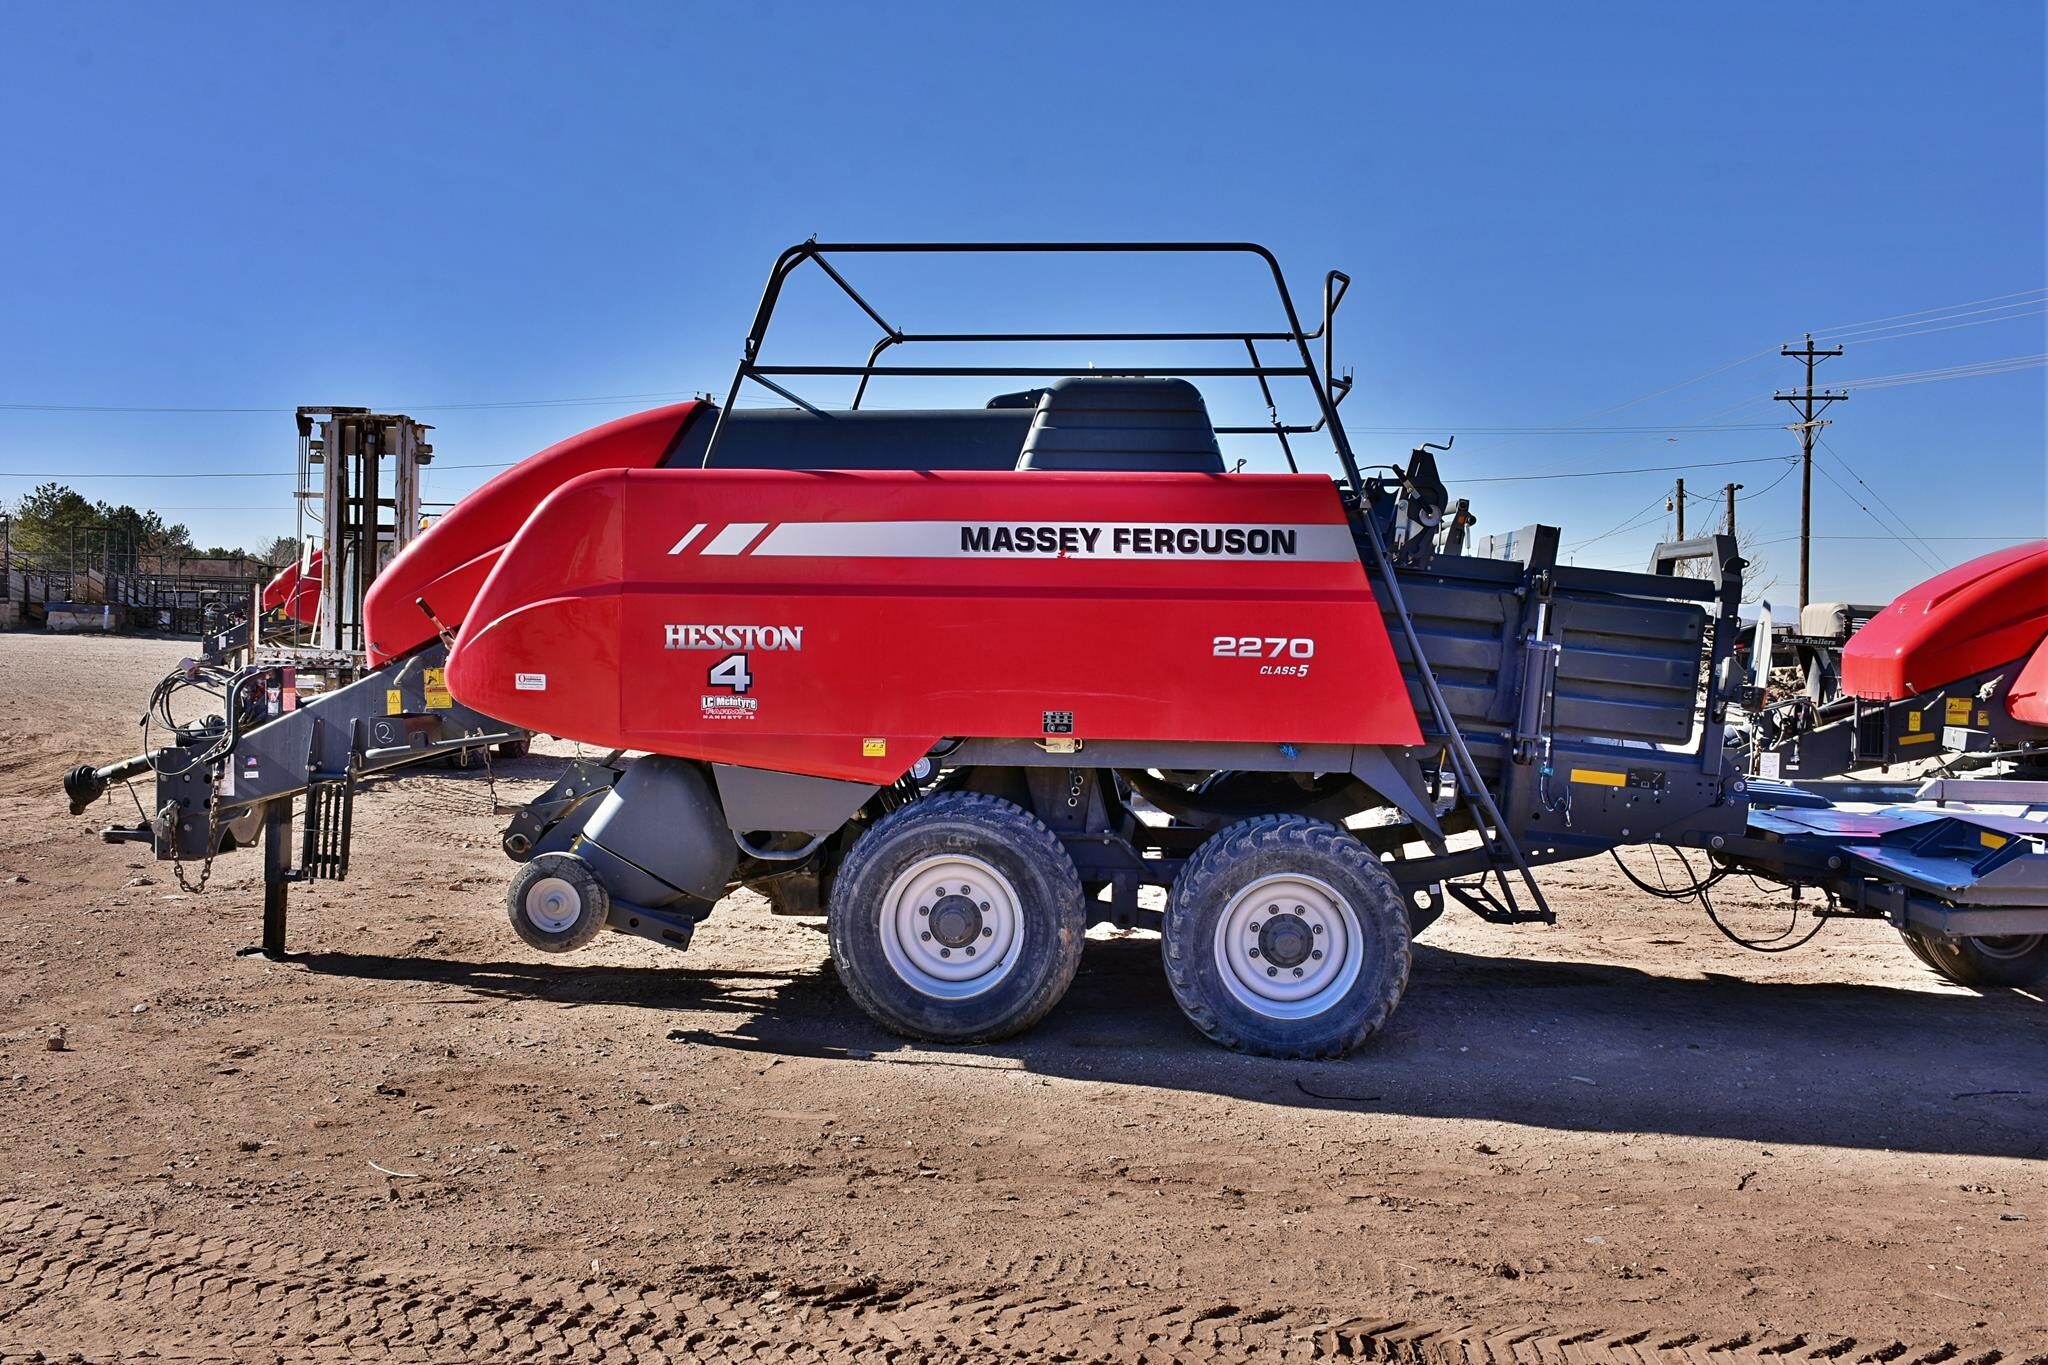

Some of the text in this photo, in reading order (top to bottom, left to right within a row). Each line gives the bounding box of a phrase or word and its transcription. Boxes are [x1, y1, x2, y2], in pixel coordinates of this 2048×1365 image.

[961, 526, 1296, 555] MASSEY FERGUSON
[664, 624, 804, 651] HESSTON
[1781, 635, 1836, 646] Texas Trailers
[1212, 636, 1314, 659] 2270
[709, 653, 753, 693] 4
[1260, 664, 1309, 678] CLASS 5
[702, 696, 756, 709] LC McIntyre
[378, 724, 392, 740] 2
